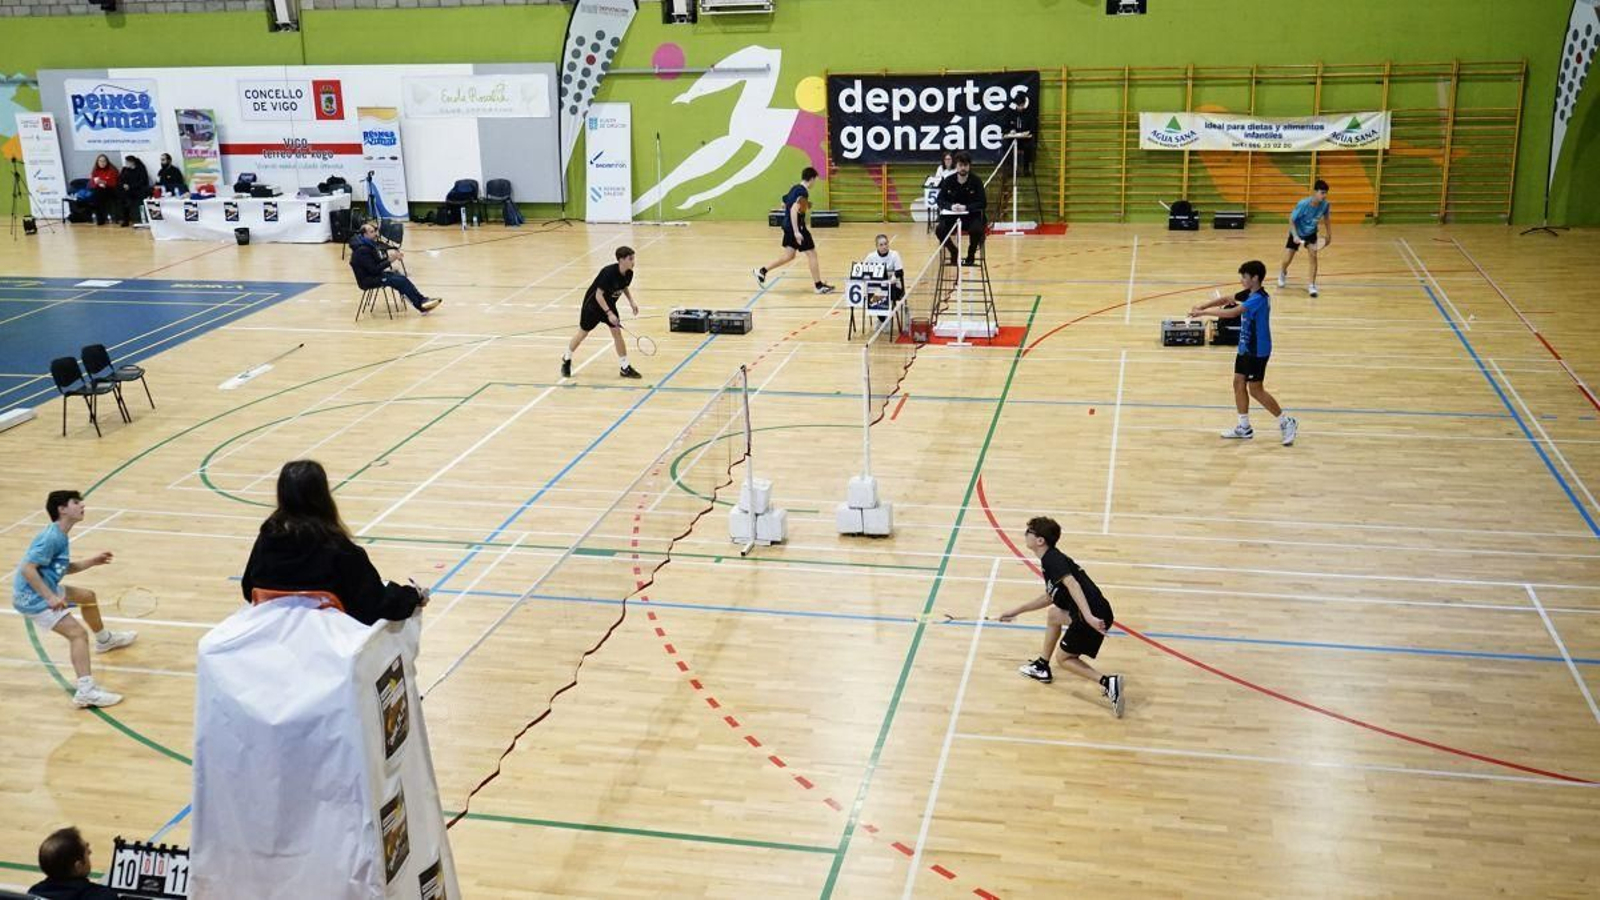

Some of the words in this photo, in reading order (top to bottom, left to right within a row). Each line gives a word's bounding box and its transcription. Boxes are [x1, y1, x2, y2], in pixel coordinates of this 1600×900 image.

[244, 88, 303, 100] CONCELLO
[838, 79, 1030, 121] deportes
[71, 93, 149, 115] peixes
[253, 102, 267, 112] DE
[270, 101, 298, 112] VIGO
[1247, 123, 1273, 131] dietas
[1282, 123, 1325, 131] alimentos
[839, 115, 1003, 159] gonzále
[1151, 129, 1173, 143] AGUA
[1174, 129, 1197, 143] SANA
[1243, 131, 1283, 139] infantiles
[1331, 130, 1353, 143] AGUA
[1354, 129, 1378, 142] SANA
[928, 191, 937, 205] 5
[849, 284, 861, 304] 6
[117, 859, 136, 887] 10
[144, 858, 151, 873] 0
[158, 860, 164, 875] 0
[171, 865, 189, 893] 11
